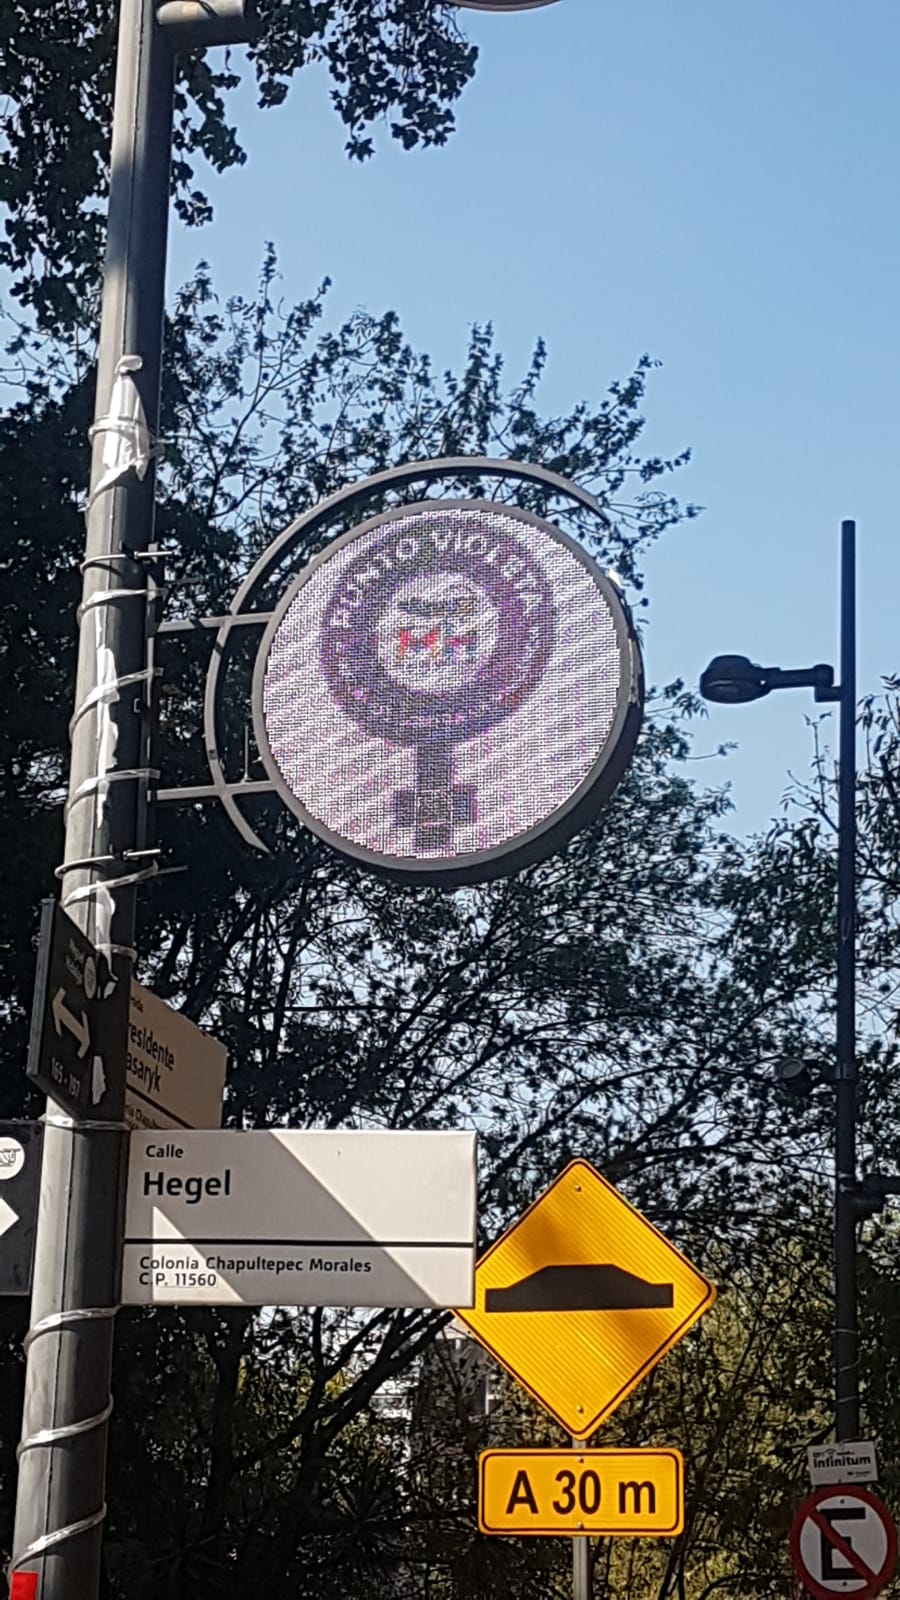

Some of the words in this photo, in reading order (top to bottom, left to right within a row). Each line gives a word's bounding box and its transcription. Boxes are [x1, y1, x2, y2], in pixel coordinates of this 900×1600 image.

[330, 533, 421, 630] PUNTO
[430, 530, 544, 616] VIOLETA
[128, 1023, 174, 1071] esidente
[126, 1052, 161, 1093] asaryk
[145, 1144, 184, 1159] Calle
[142, 1169, 231, 1204] Hegel
[138, 1272, 169, 1286] C.P.
[175, 1273, 217, 1287] 11560
[139, 1256, 199, 1271] Colonia
[205, 1257, 303, 1275] Chapultepec
[309, 1258, 372, 1273] Morales
[813, 1455, 871, 1469] infinitum
[505, 1470, 539, 1514] A
[553, 1469, 601, 1515] 30
[618, 1481, 656, 1514] m
